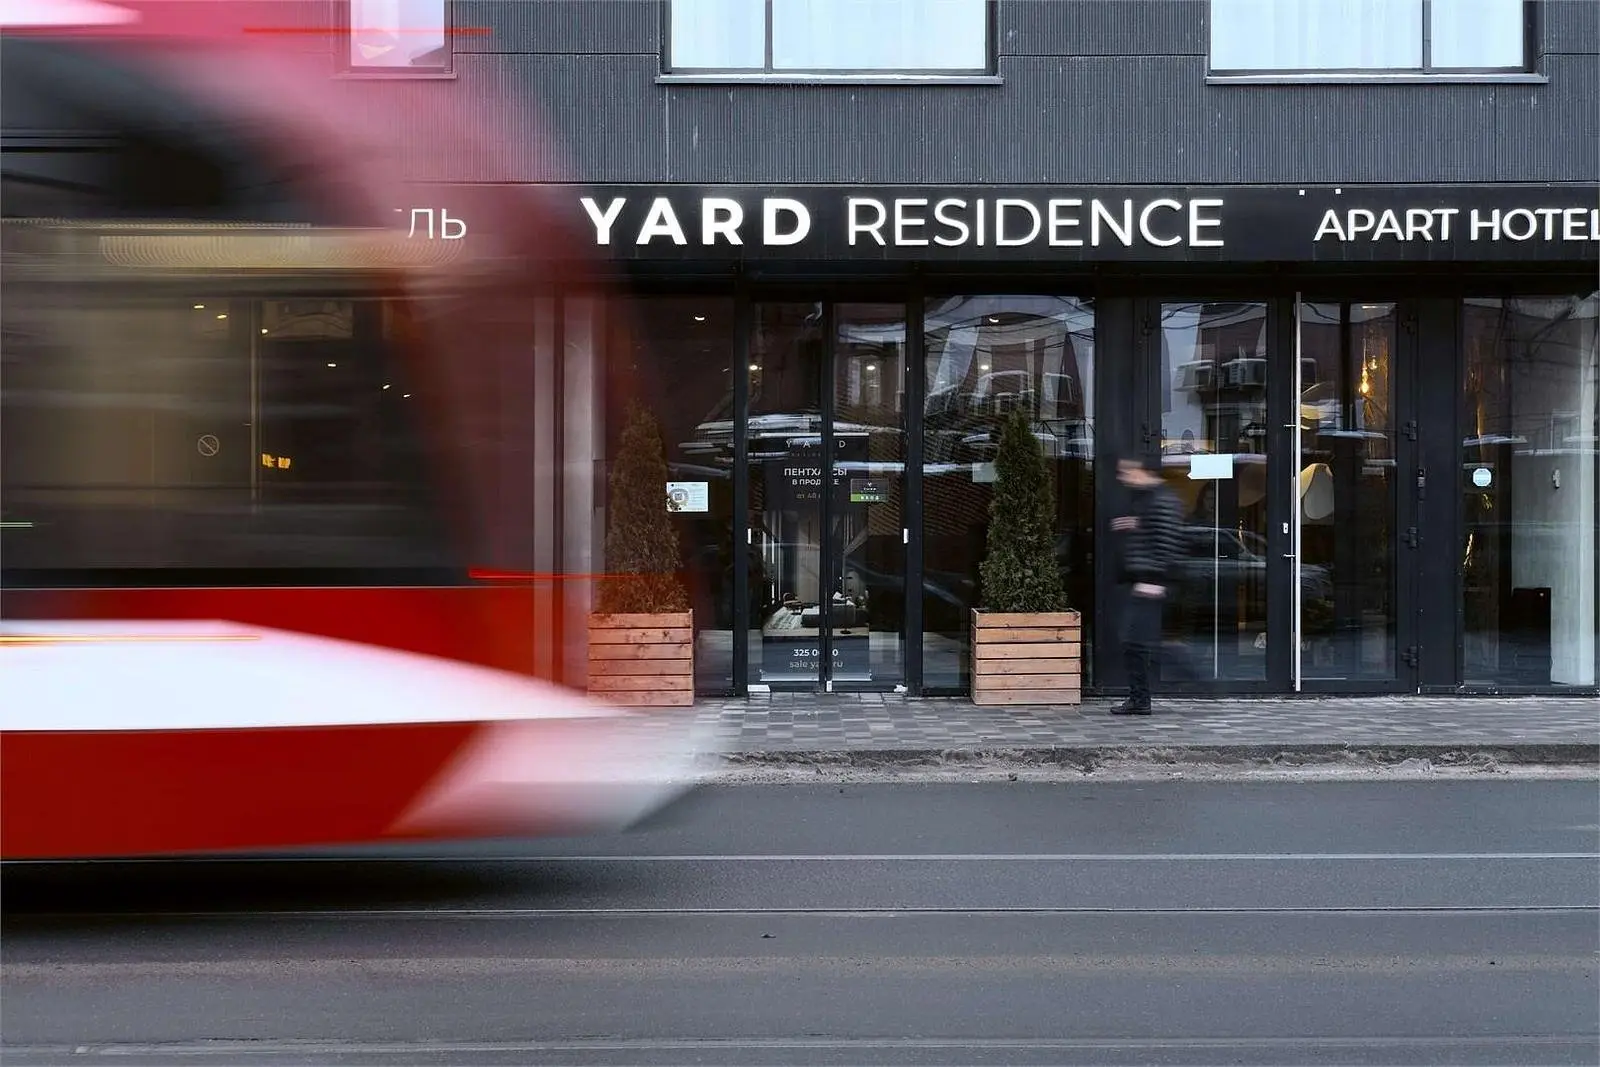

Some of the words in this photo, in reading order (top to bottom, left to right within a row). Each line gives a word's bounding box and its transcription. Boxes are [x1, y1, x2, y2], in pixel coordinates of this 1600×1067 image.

[394, 208, 467, 239] ЛЬ
[580, 197, 811, 246] YARD
[847, 198, 1225, 247] RESIDENCE
[1313, 208, 1459, 241] APART
[786, 440, 846, 448] YAD
[793, 649, 810, 657] 325
